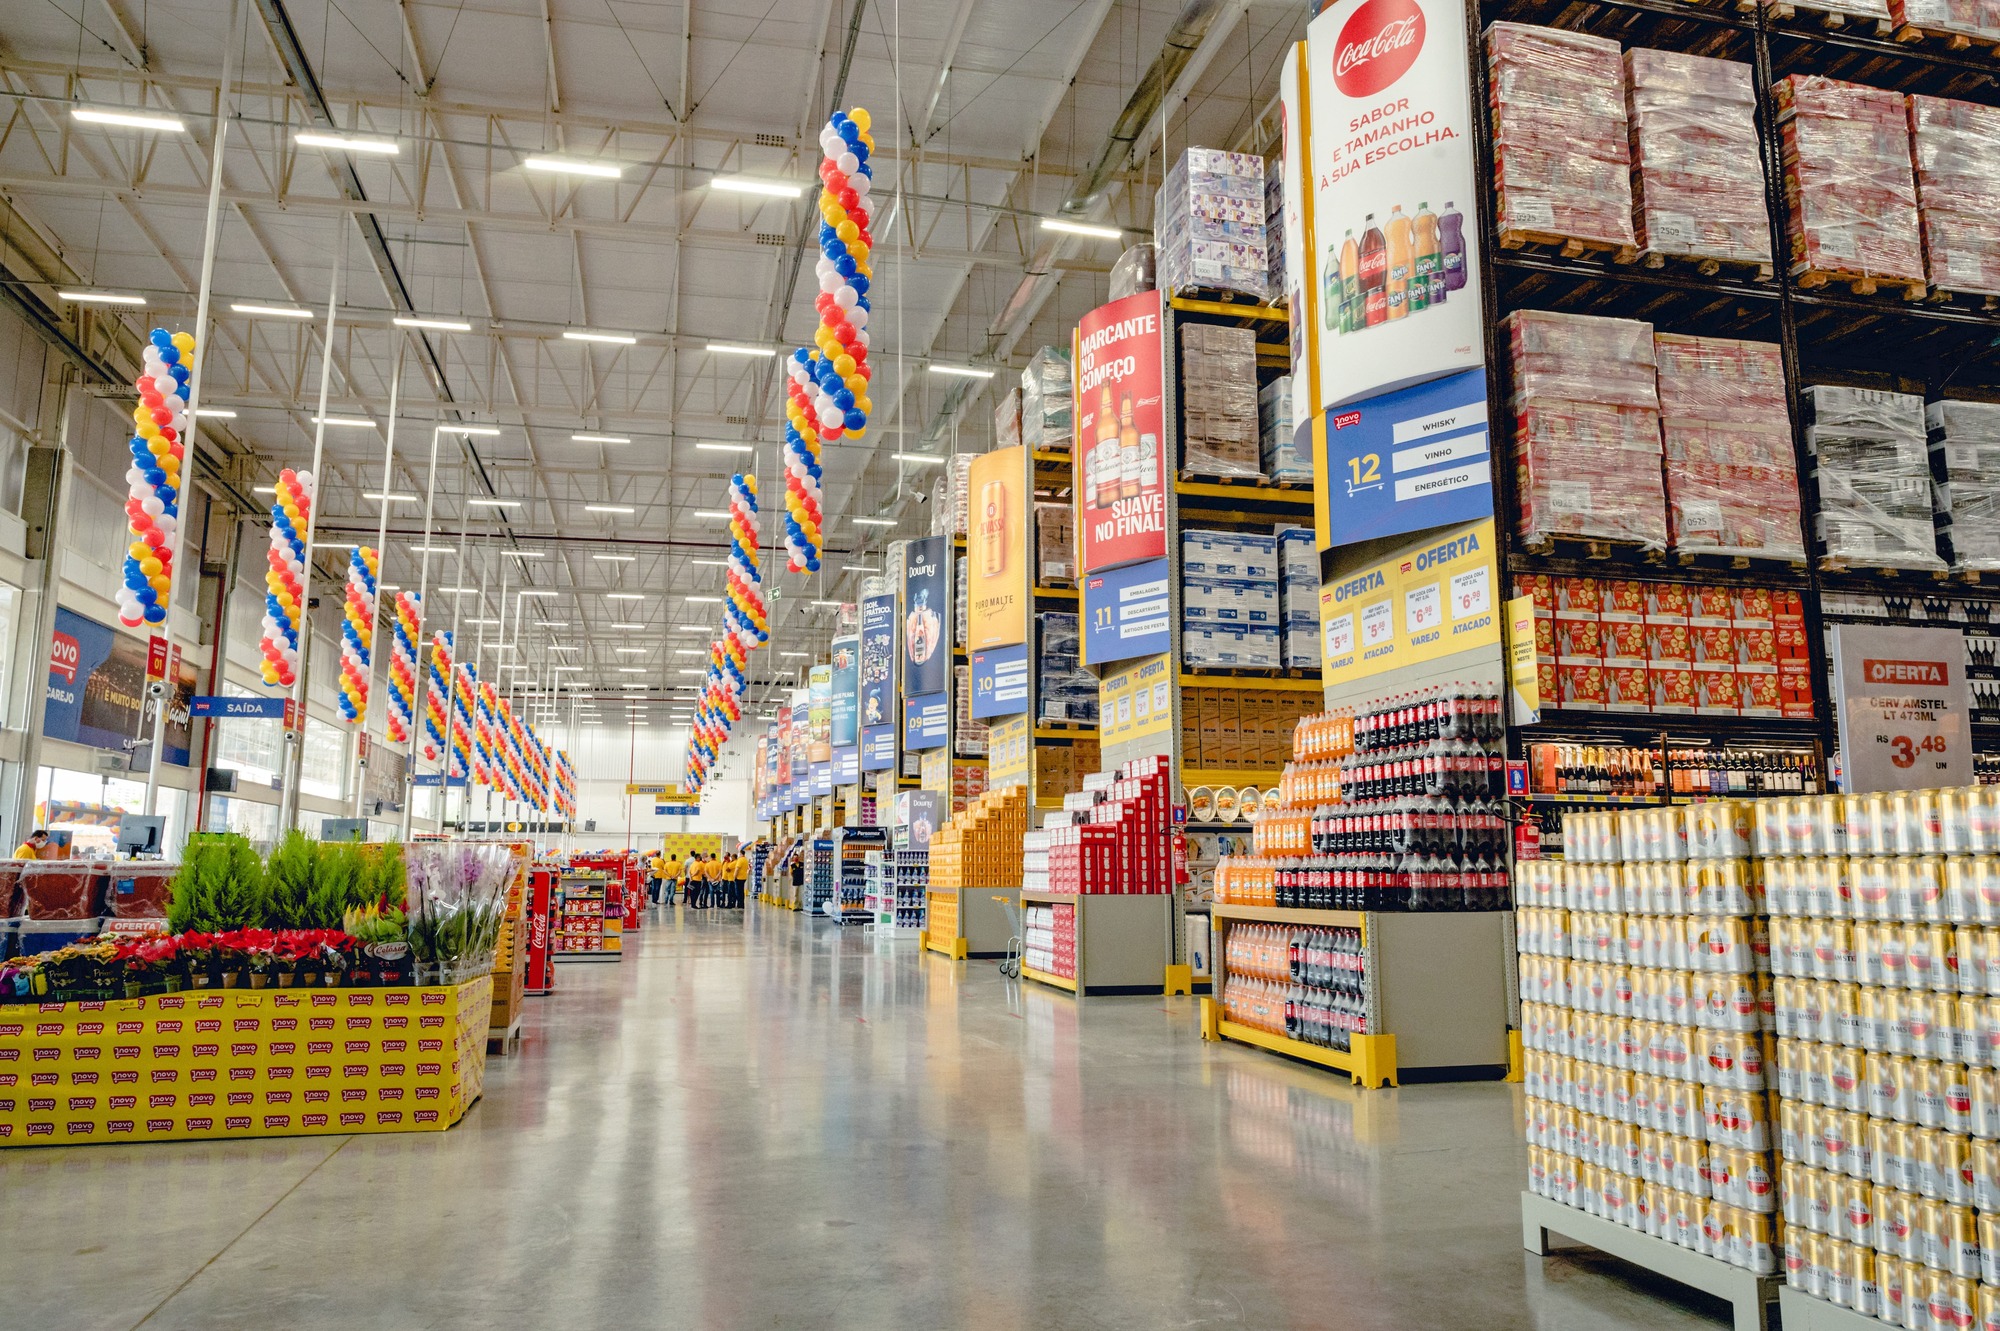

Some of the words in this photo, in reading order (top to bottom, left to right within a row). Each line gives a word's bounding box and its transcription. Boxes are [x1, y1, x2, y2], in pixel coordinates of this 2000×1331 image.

[1336, 13, 1420, 76] Coca-Cola
[1350, 98, 1409, 132] SABOR
[1333, 148, 1341, 162] E
[1345, 111, 1435, 154] TAMANHO
[1320, 175, 1329, 191] À
[1332, 159, 1361, 183] SUA
[1365, 127, 1460, 165] ESCOLHA.
[1081, 314, 1156, 358] MARCANTE
[1081, 352, 1095, 375] NO
[1081, 355, 1136, 394] COMEÇO
[1422, 417, 1456, 431] WHISKY
[1424, 448, 1452, 460] VINHO
[1348, 453, 1381, 485] 12
[1414, 474, 1469, 492] ENERGÉTICO
[1112, 494, 1163, 519] SUAVE
[1095, 521, 1114, 543] NO
[1117, 513, 1164, 537] FINAL
[1416, 533, 1480, 571] OFERTA
[909, 564, 935, 578] Downy
[1130, 587, 1160, 597] EMBALAGENS
[1335, 570, 1385, 602] OFERTA
[975, 600, 988, 610] PURO
[990, 595, 1013, 606] MALTE
[1096, 606, 1111, 626] 11
[1453, 616, 1491, 635] ATACADO
[1411, 631, 1440, 646] VAREJO
[1513, 640, 1534, 650] CONSULTE
[52, 640, 78, 663] ovo
[1364, 644, 1394, 660] ATACADO
[1519, 647, 1532, 655] PREÇO
[154, 658, 162, 671] 01
[1140, 660, 1165, 679] OFERTA
[1331, 656, 1354, 669] VAREJO
[1872, 664, 1941, 681] OFERTA
[979, 676, 993, 691] 10
[1106, 675, 1128, 692] OFERTA
[110, 692, 130, 708] MUITO
[226, 702, 263, 713] SAÍDA
[1870, 697, 1899, 708] CERV
[1903, 699, 1948, 710] AMSTEL
[909, 716, 922, 729] 09
[1884, 711, 1896, 720] LT
[1900, 711, 1937, 721] 473ML
[1891, 735, 1946, 768] 3,48
[913, 800, 932, 808] Downy
[114, 922, 156, 931] OFERTA
[532, 913, 546, 949] Coca-Cola
